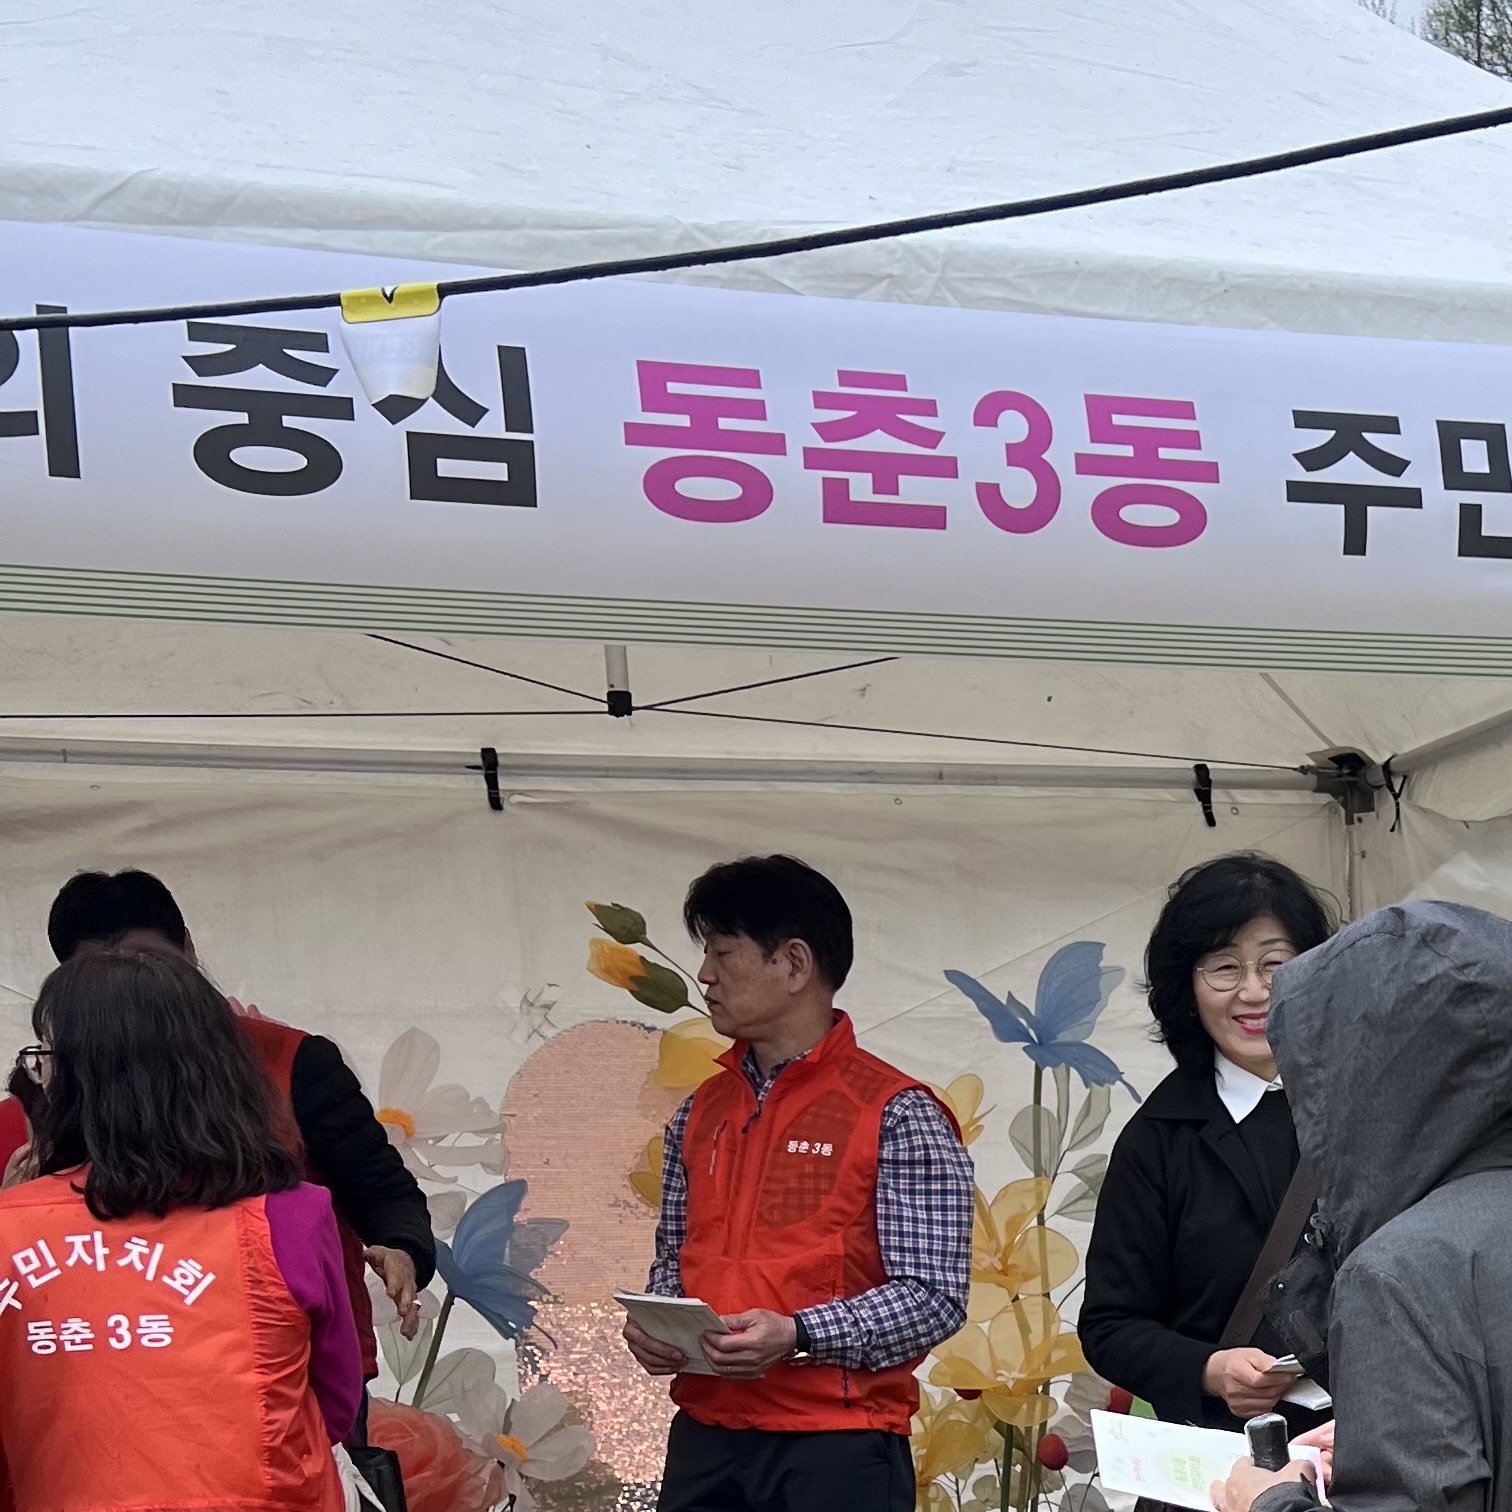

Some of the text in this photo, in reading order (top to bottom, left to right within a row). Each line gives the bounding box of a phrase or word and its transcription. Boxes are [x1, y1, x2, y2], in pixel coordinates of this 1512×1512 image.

[172, 320, 538, 508] 중심
[623, 359, 1220, 548] 동춘3동
[812, 1142, 833, 1156] 3동
[27, 1314, 174, 1355] 동춘 3동
